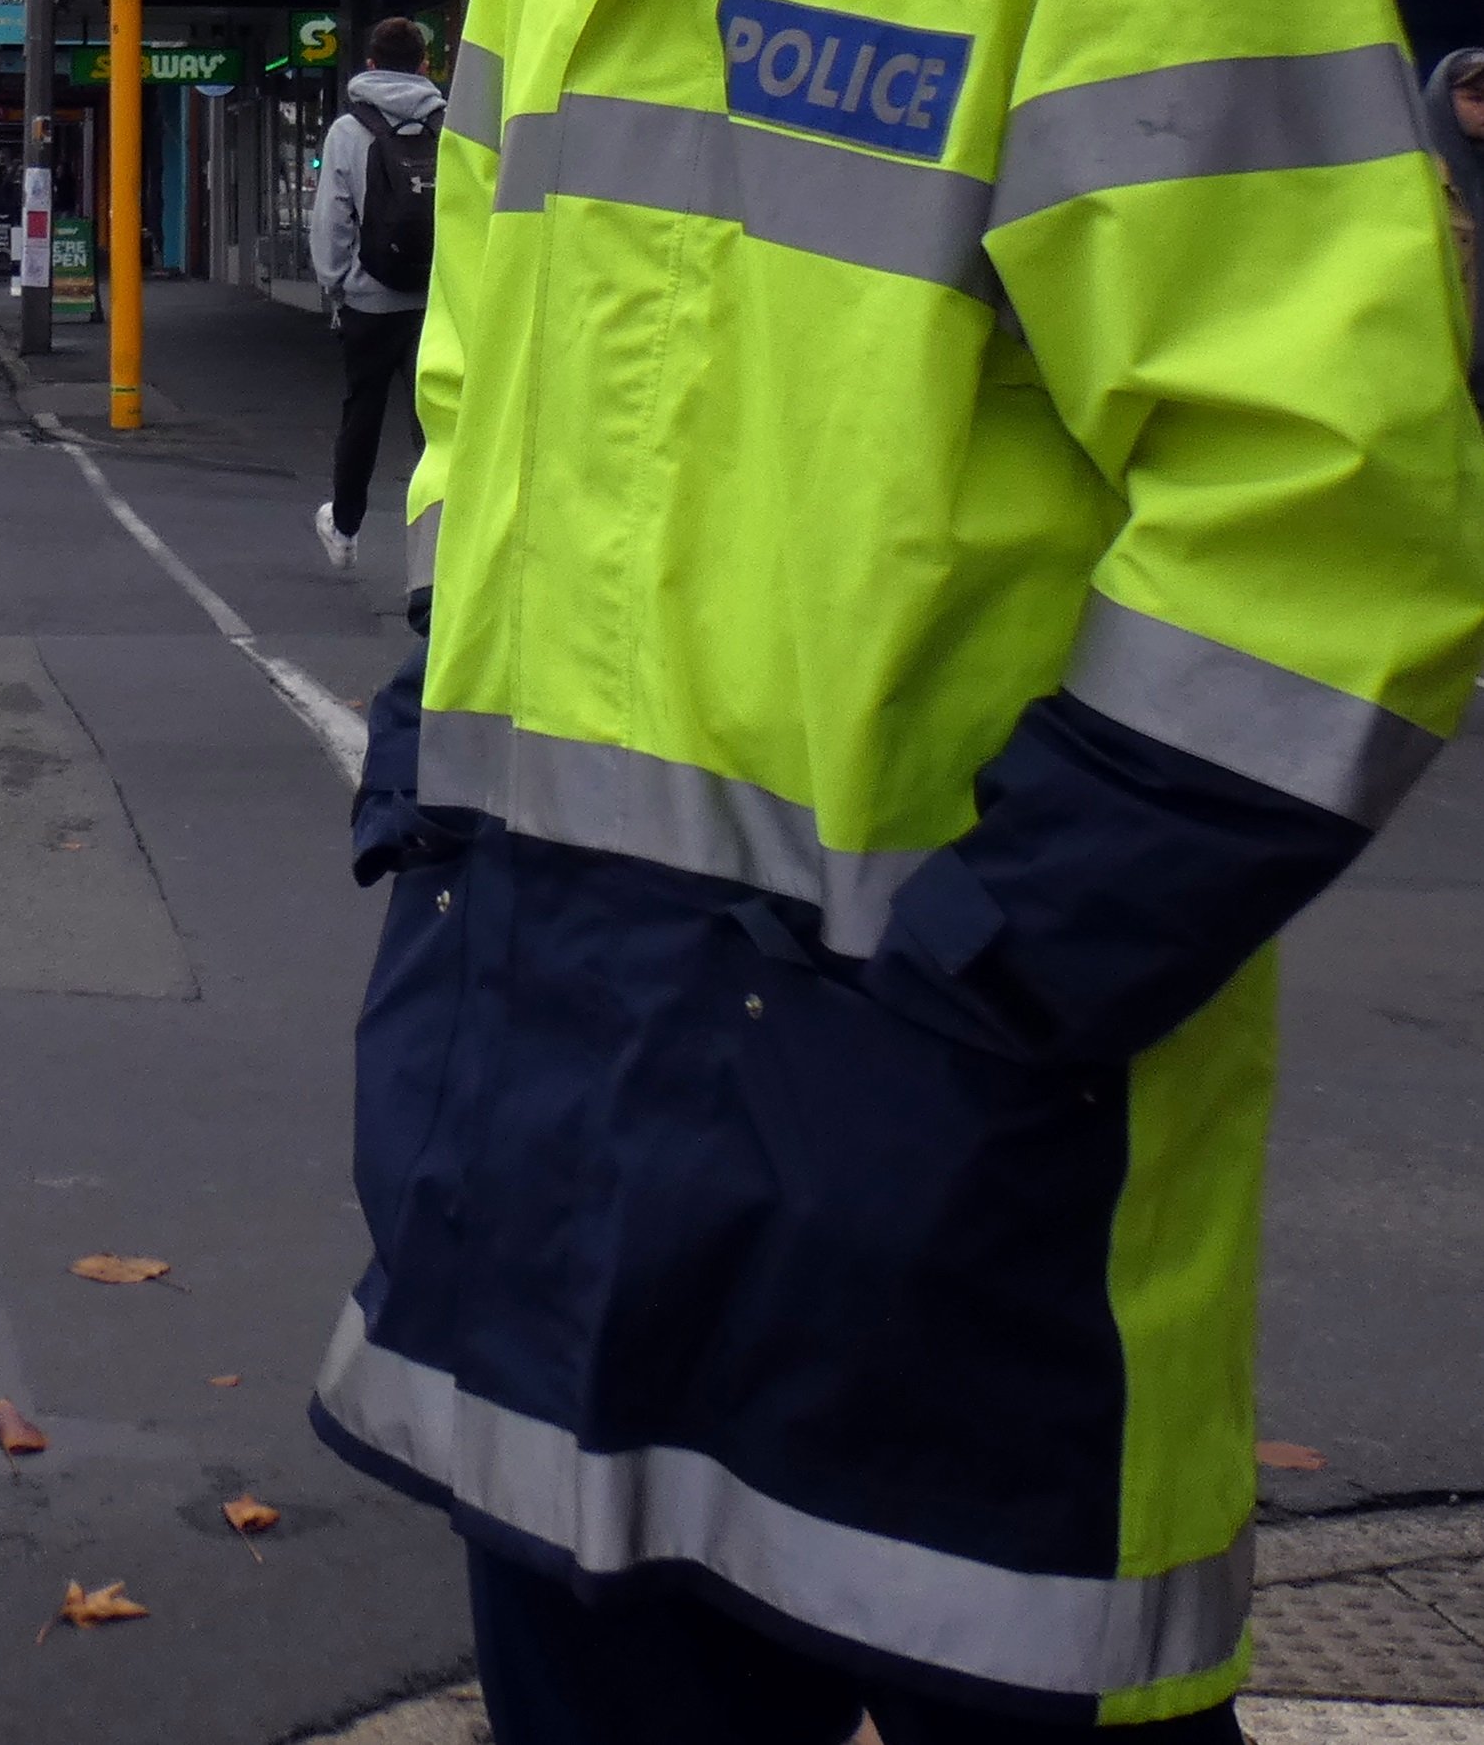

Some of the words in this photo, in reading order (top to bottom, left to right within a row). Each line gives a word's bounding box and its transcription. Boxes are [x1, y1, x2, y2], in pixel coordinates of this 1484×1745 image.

[90, 54, 227, 79] SWAY
[727, 16, 946, 129] POLICE
[53, 240, 87, 253] E'RE
[52, 254, 87, 267] PEN
